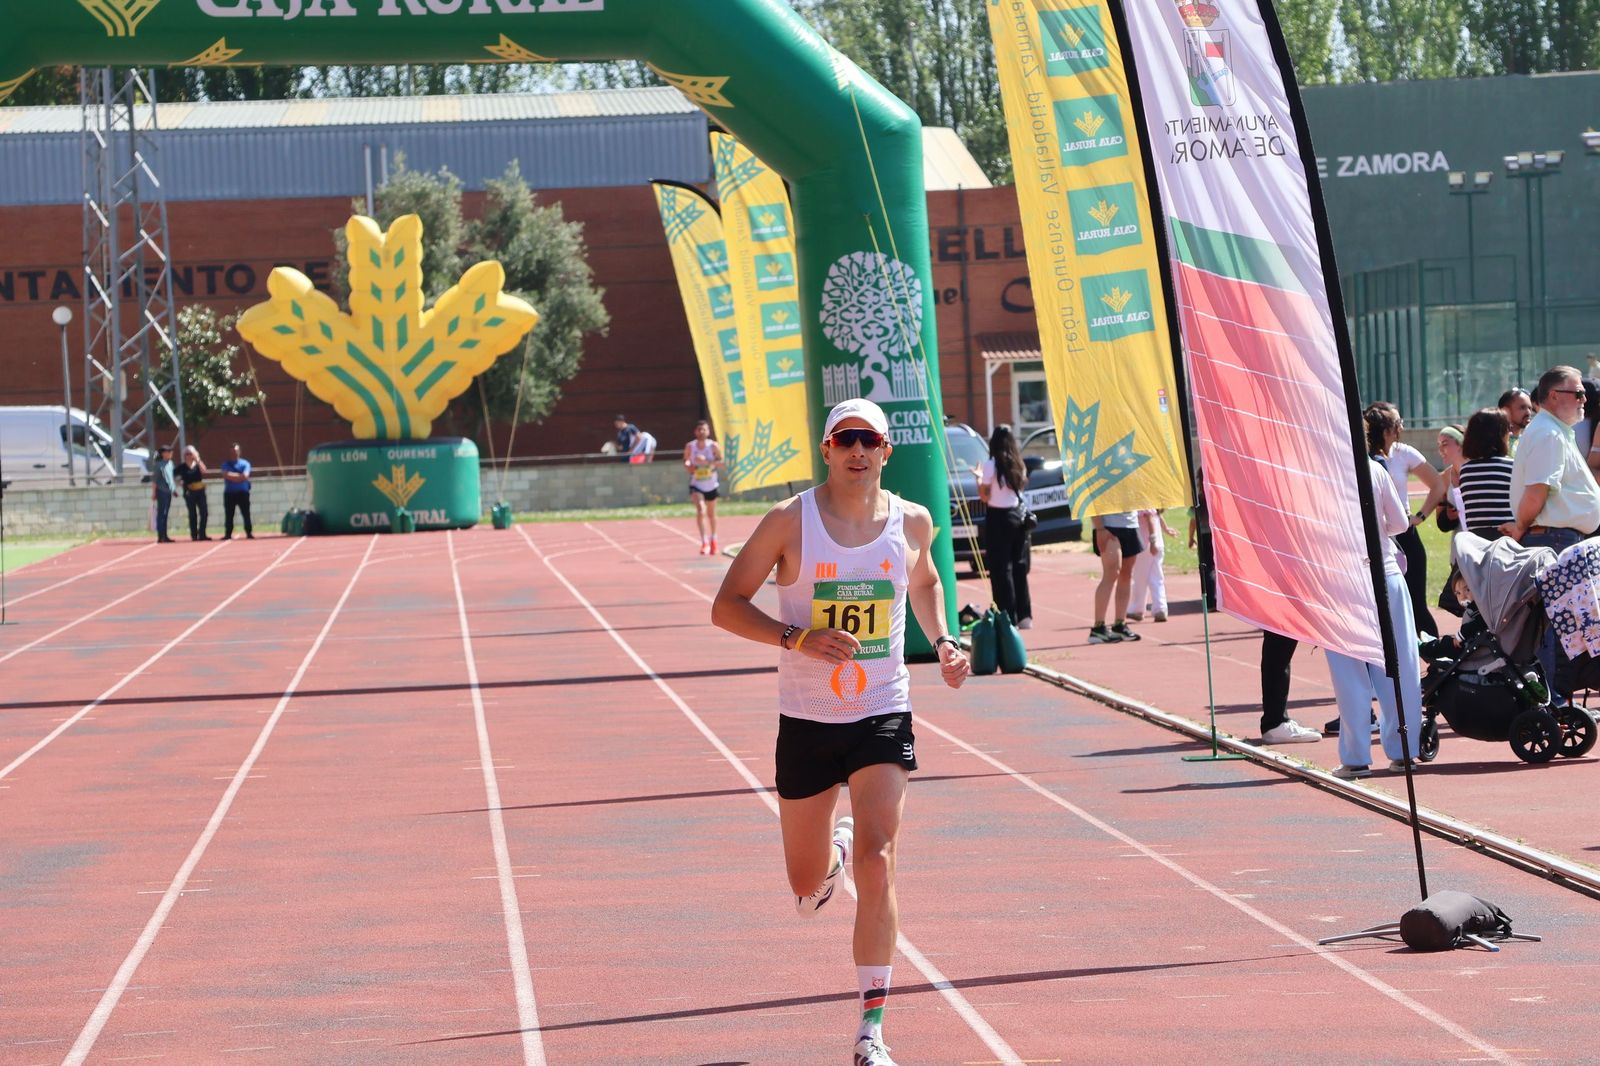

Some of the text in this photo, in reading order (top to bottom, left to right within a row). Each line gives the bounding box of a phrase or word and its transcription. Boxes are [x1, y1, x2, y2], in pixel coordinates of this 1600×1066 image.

[1337, 150, 1450, 178] ZAMORA
[387, 448, 437, 460] OURENSE
[350, 512, 391, 528] CAJA
[822, 603, 876, 635] 161
[859, 644, 887, 655] RURAL
